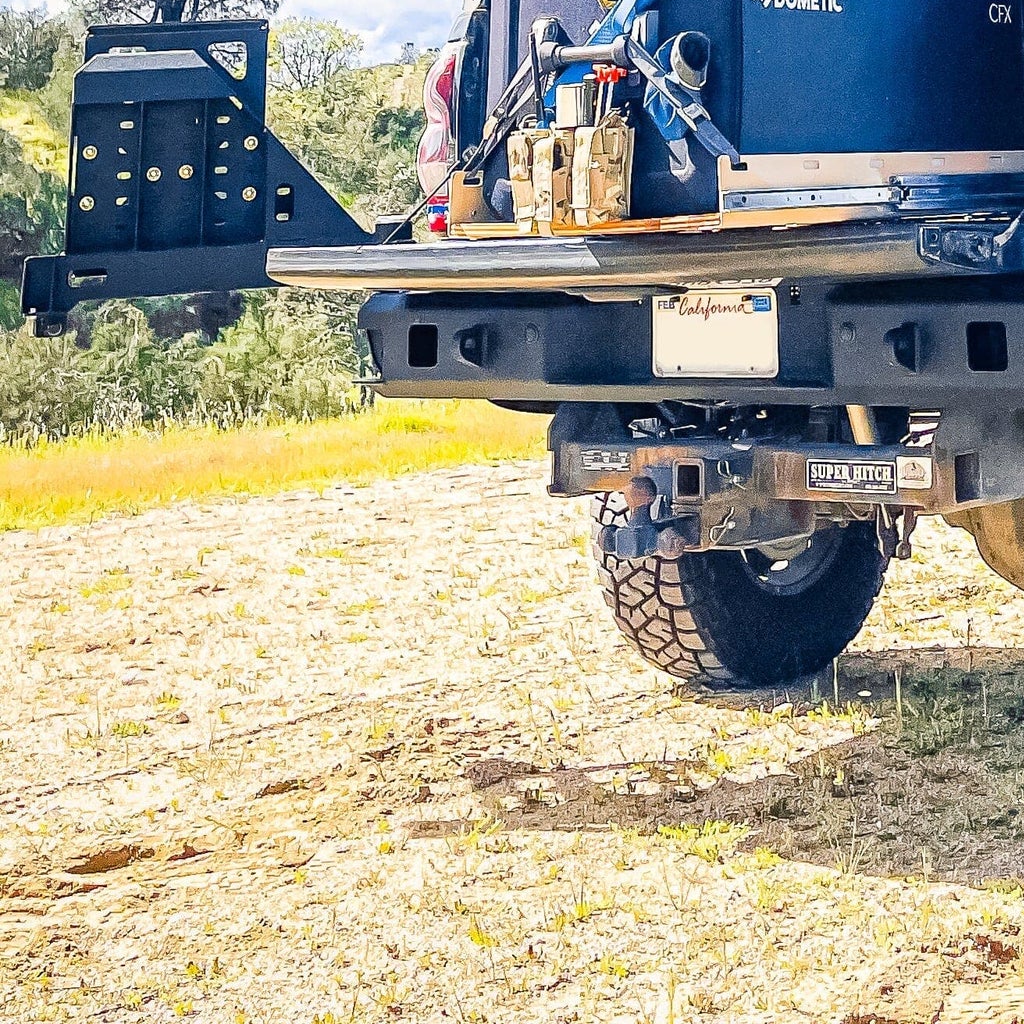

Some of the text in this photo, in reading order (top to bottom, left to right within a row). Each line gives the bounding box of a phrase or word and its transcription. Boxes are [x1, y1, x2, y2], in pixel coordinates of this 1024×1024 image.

[989, 3, 1012, 24] CFX
[657, 300, 676, 310] FEB
[679, 296, 754, 321] California
[810, 463, 894, 481] SUPER HITCH
